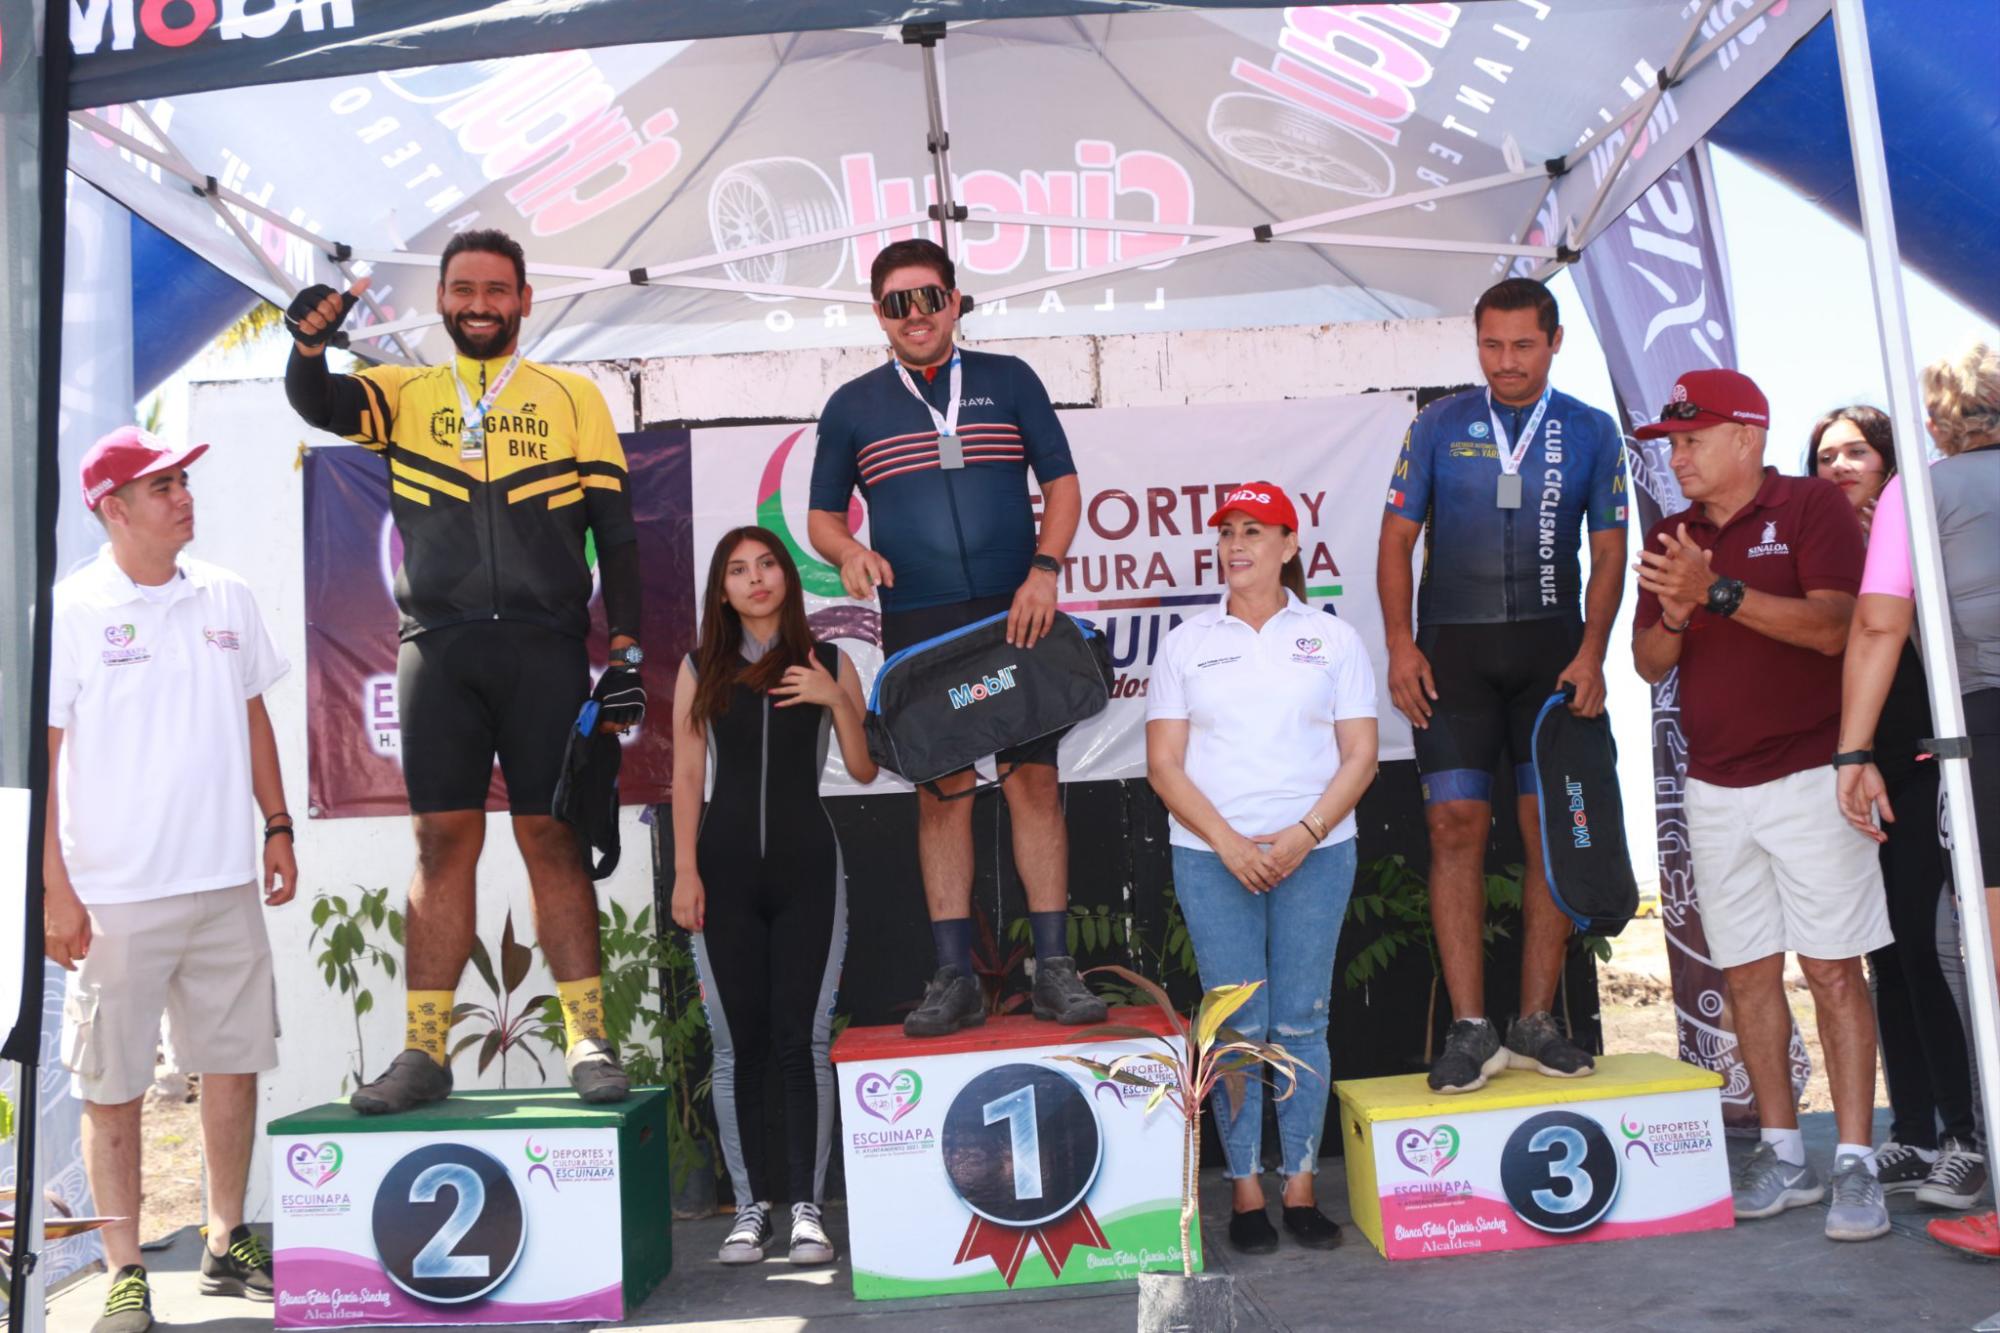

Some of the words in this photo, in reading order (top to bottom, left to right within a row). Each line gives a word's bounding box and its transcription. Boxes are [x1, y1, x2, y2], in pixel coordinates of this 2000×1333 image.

[509, 440, 548, 460] BIKE
[1545, 419, 1562, 463] CLUB
[1300, 491, 1327, 528] Y
[1539, 469, 1562, 560] CICLISMO
[1540, 564, 1557, 606] RUIZ
[948, 666, 1016, 710] Mobil
[1566, 781, 1592, 848] Mobil
[1648, 1121, 1700, 1134] DEPORTES
[1703, 1120, 1709, 1129] Y
[853, 1128, 934, 1146] ESCUINAPA
[983, 1085, 1043, 1200] 1
[1649, 1132, 1685, 1142] CULTURA
[1653, 1139, 1713, 1153] ESCUINAPA
[552, 1149, 604, 1159] DEPORTES
[607, 1149, 613, 1158] Y
[556, 1168, 615, 1178] ESCUINAPA
[1527, 1125, 1594, 1214] 3
[1394, 1180, 1473, 1197] ESCUINAPA
[281, 1193, 351, 1206] ESCUINAPA
[408, 1163, 490, 1278] 2
[1421, 1239, 1481, 1253] Alcaldesa
[303, 1308, 364, 1320] Alcaldesa
